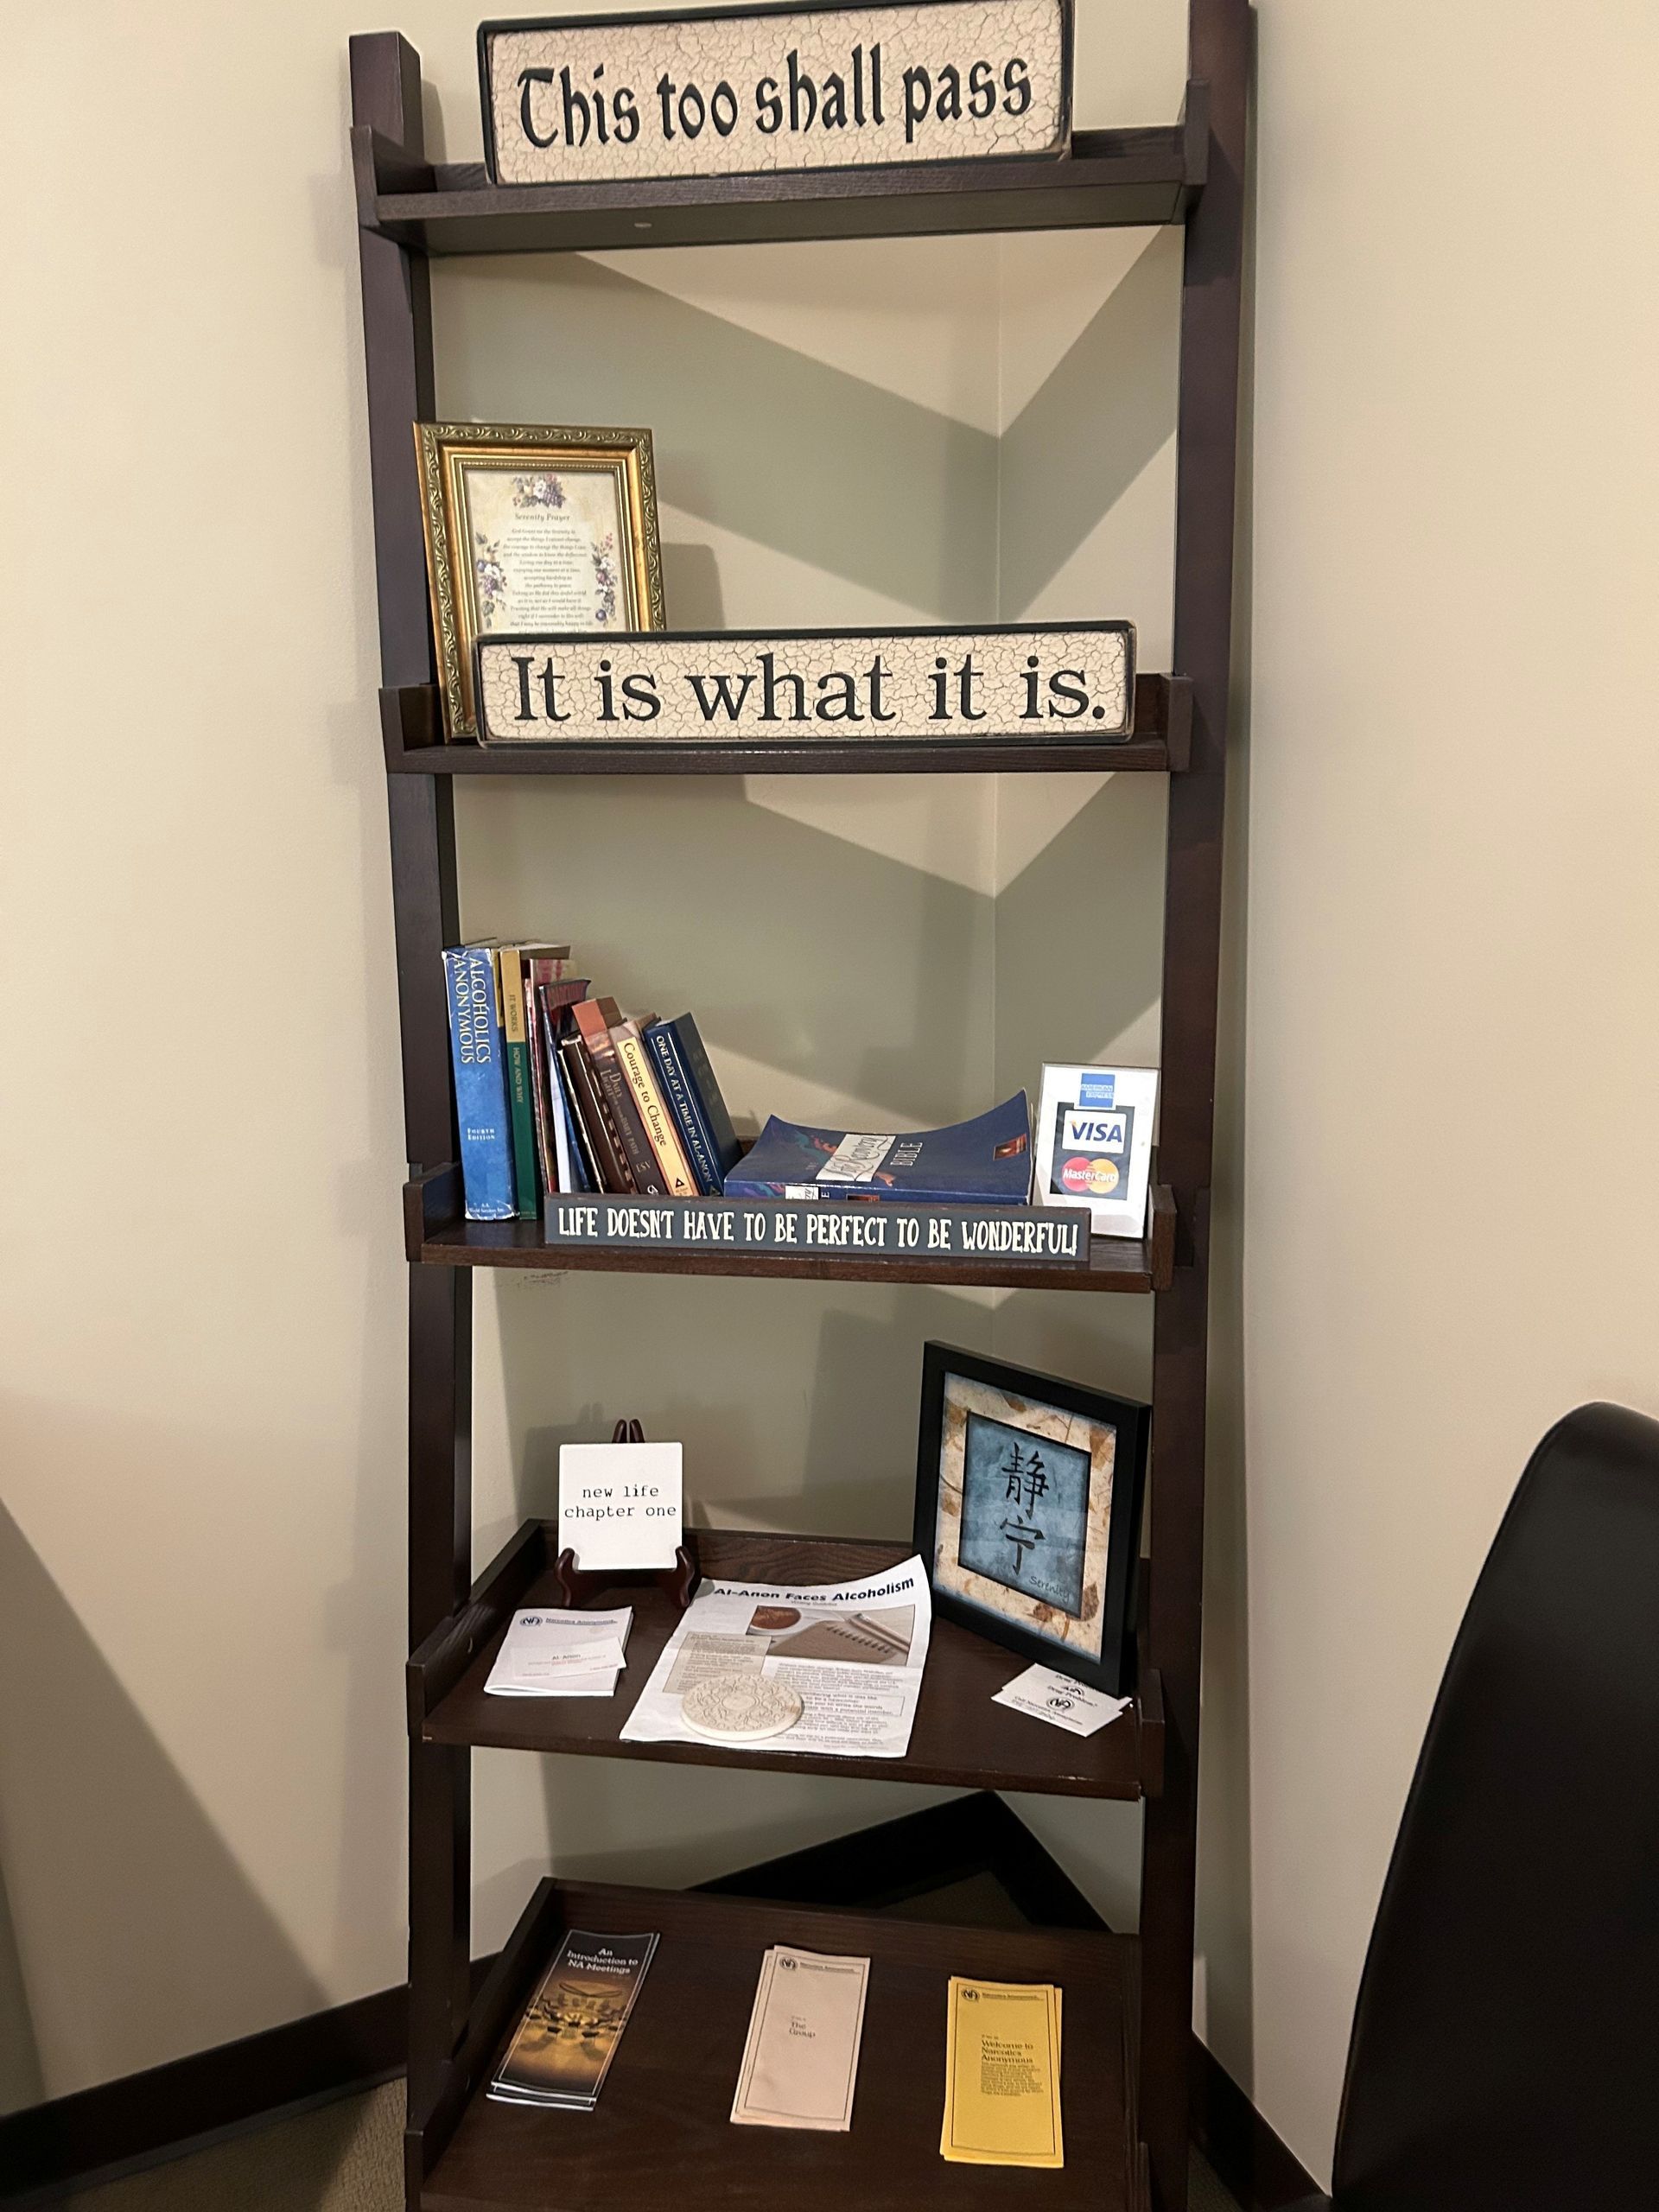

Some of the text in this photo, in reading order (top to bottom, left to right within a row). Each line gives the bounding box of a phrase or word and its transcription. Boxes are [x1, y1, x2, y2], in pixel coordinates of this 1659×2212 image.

[518, 42, 1033, 149] This too shall pass
[514, 512, 570, 522] Serenity Prayer
[512, 653, 1107, 722] It is what it is.
[454, 958, 474, 1064] ANONYMOUS
[469, 957, 492, 1064] ALCOHOLICS
[624, 1043, 667, 1147] Courage to Change
[656, 1035, 714, 1183] ONE DAY AT A TIME IN AL-ANON
[1071, 1121, 1122, 1142] VISA
[890, 1141, 923, 1166] BIBLE
[1063, 1168, 1118, 1183] MasterCard
[558, 1207, 1078, 1256] LIFE DOESN'T HAVE TO BE PERFECT TO BE WONDERFUL!
[582, 1483, 659, 1498] new life
[564, 1505, 677, 1522] chapter one
[714, 1577, 915, 1601] Al-Anon Faces Alcoholism
[567, 1949, 626, 1965] Introduction
[598, 1948, 613, 1956] An
[569, 1959, 630, 1974] NA Meetings
